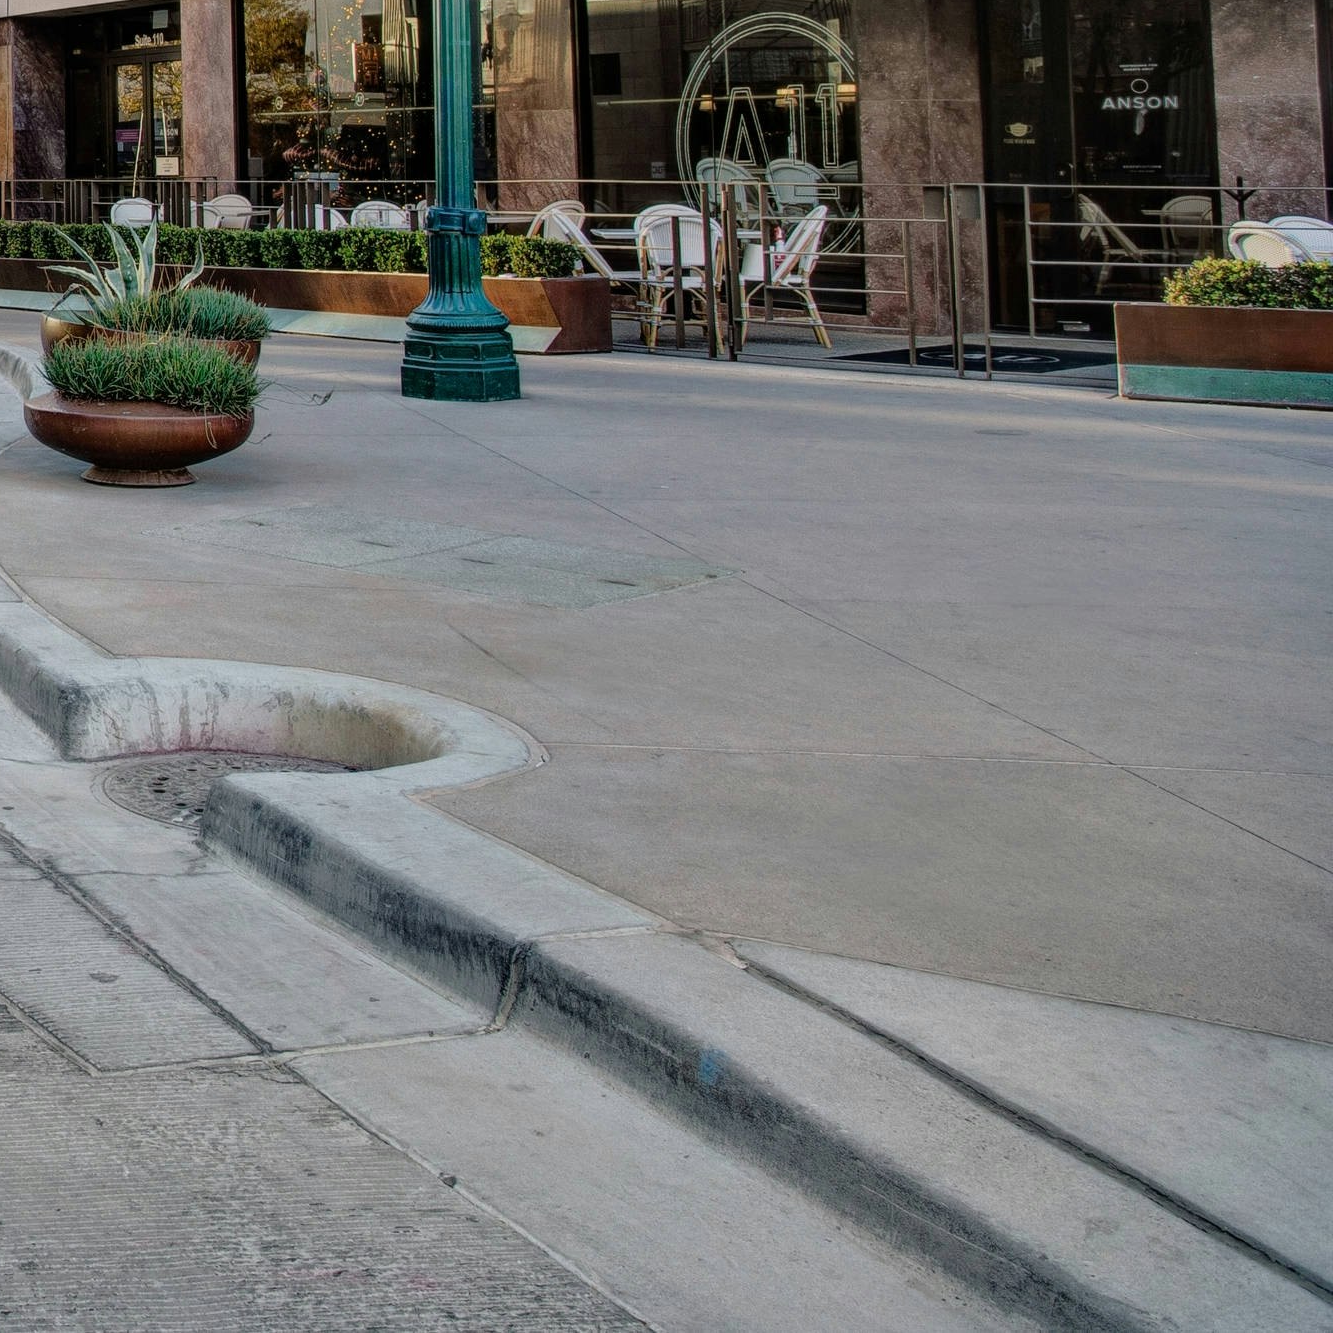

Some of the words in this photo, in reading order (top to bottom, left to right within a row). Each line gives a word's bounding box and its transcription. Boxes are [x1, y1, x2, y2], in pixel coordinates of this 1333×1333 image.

[134, 34, 152, 46] Suite
[152, 32, 164, 46] 110
[1101, 95, 1179, 110] ANSON
